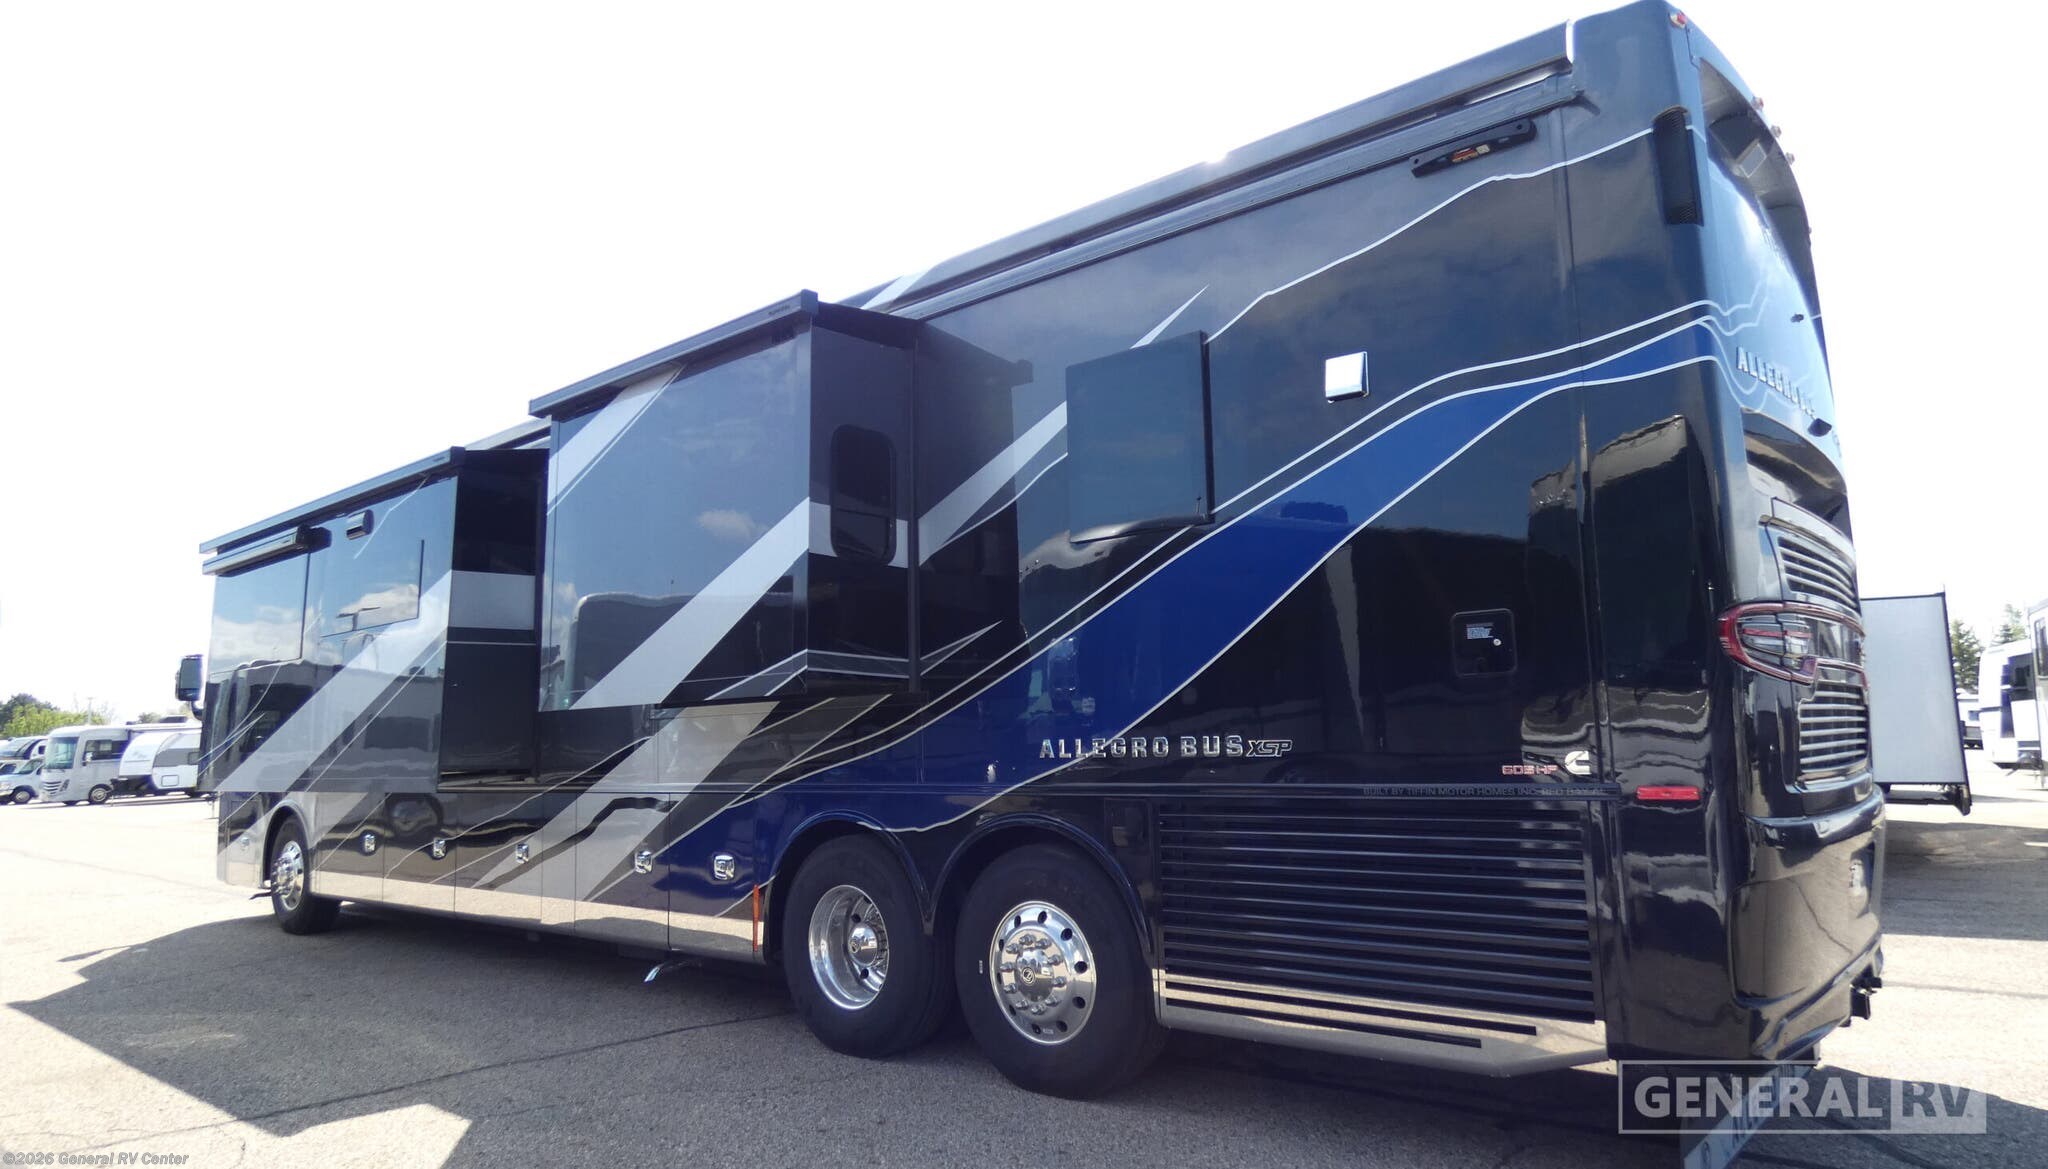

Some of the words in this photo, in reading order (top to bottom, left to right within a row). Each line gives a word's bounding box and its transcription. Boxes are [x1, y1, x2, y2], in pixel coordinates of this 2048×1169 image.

[1039, 736, 1169, 758] ALLEGRO
[1180, 734, 1244, 757] BUS
[1246, 739, 1292, 757] XSP
[1502, 764, 1535, 775] 605
[1536, 764, 1559, 775] HP
[1363, 787, 1388, 796] BUILT
[1391, 787, 1404, 796] BY
[1408, 787, 1436, 796] TIFFIN
[1439, 787, 1475, 796] MOTOR
